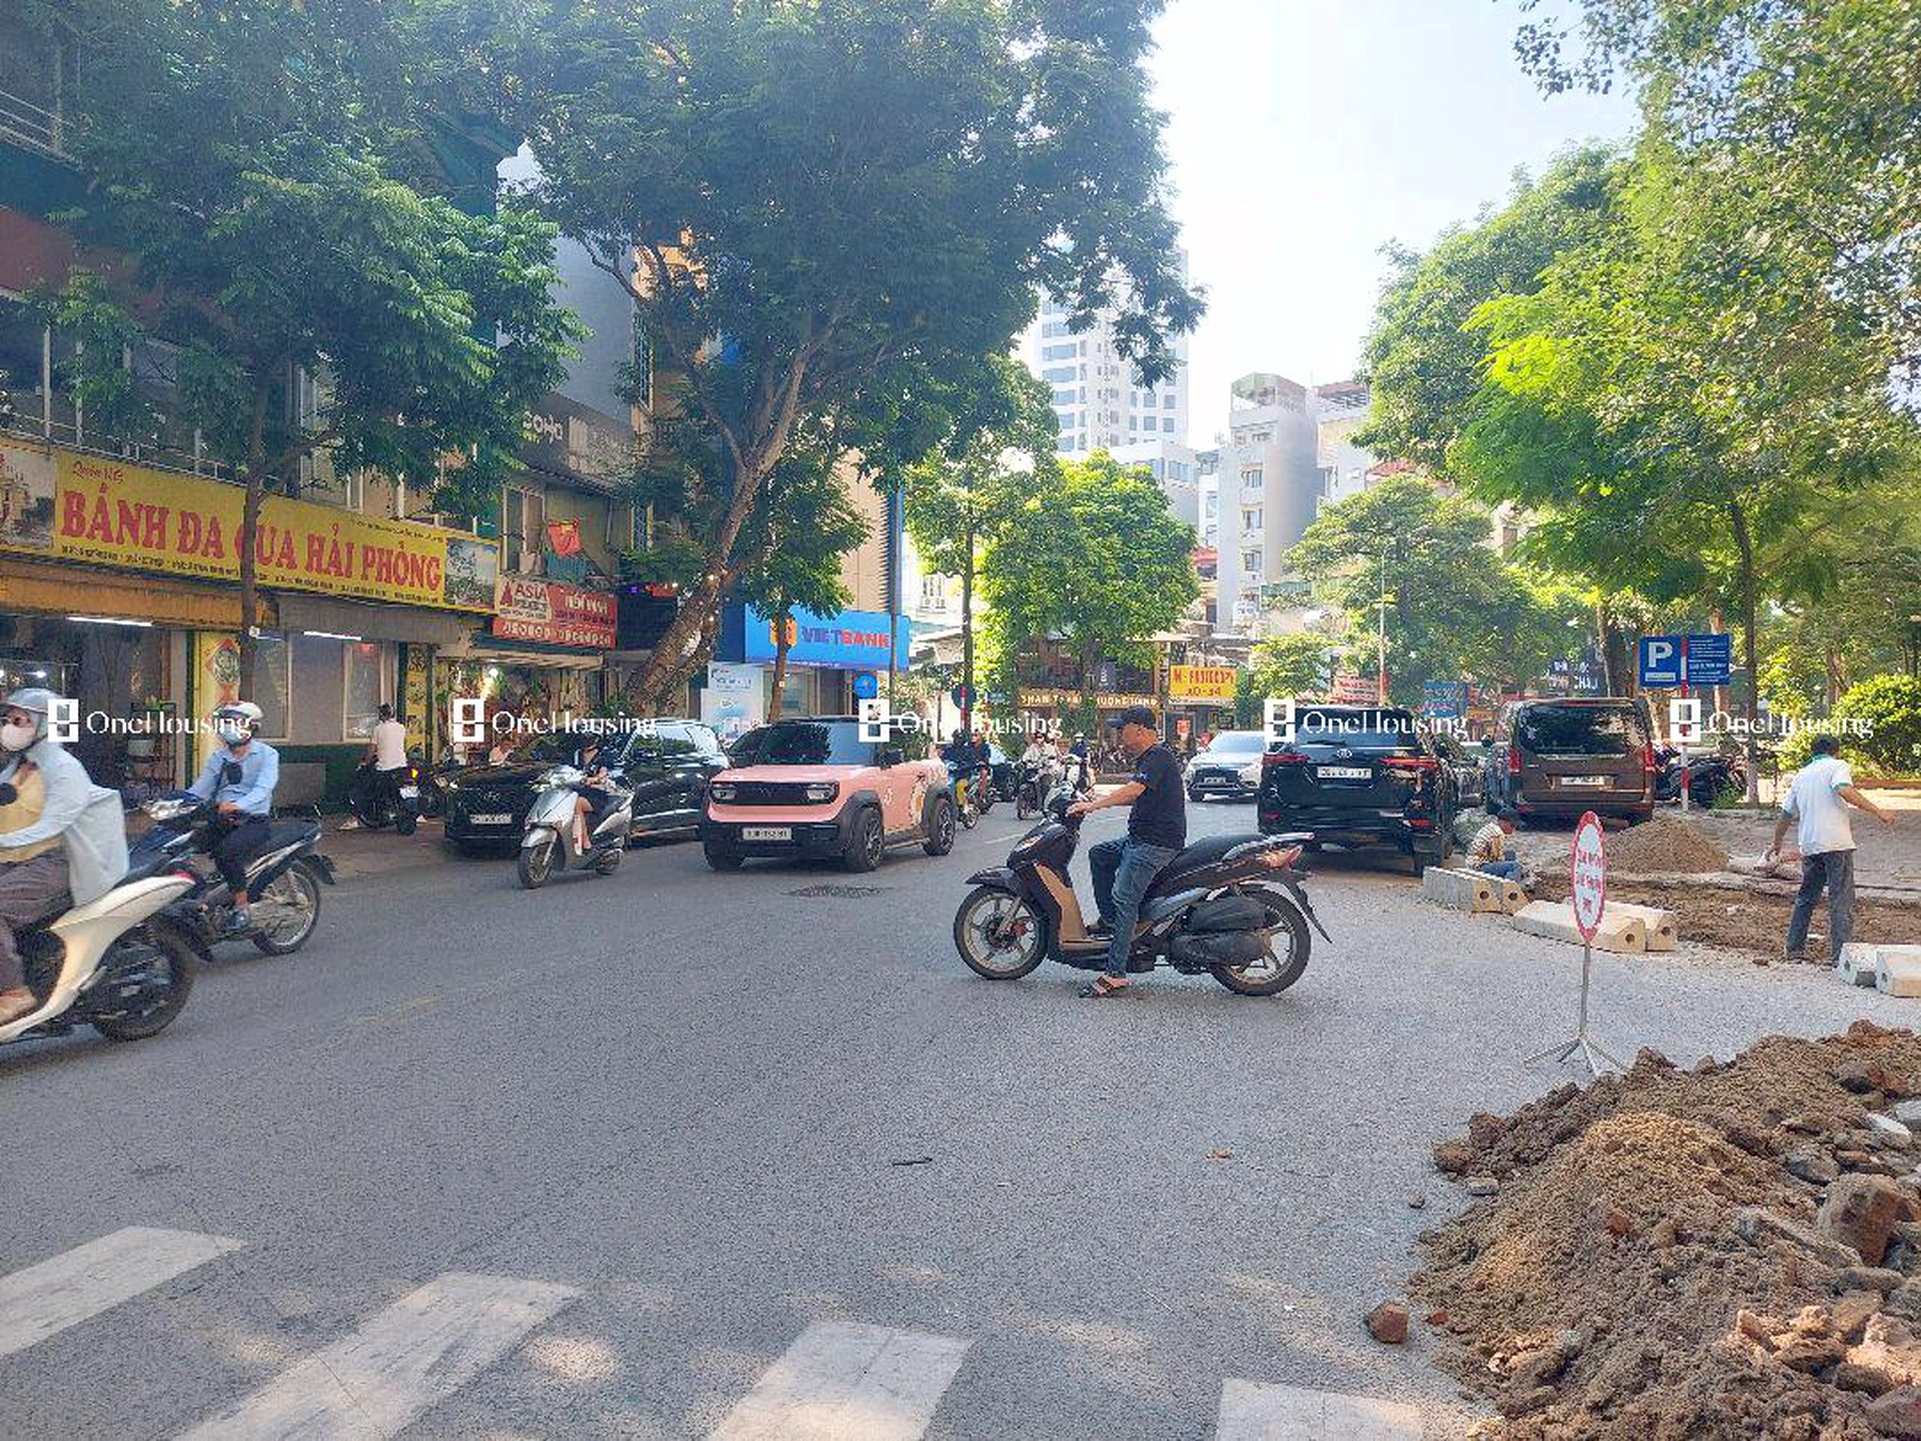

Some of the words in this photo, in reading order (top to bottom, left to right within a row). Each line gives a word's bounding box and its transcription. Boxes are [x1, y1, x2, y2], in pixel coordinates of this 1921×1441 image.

[177, 510, 225, 559] ĐA
[305, 523, 354, 579] HẢI
[1648, 641, 1673, 668] P
